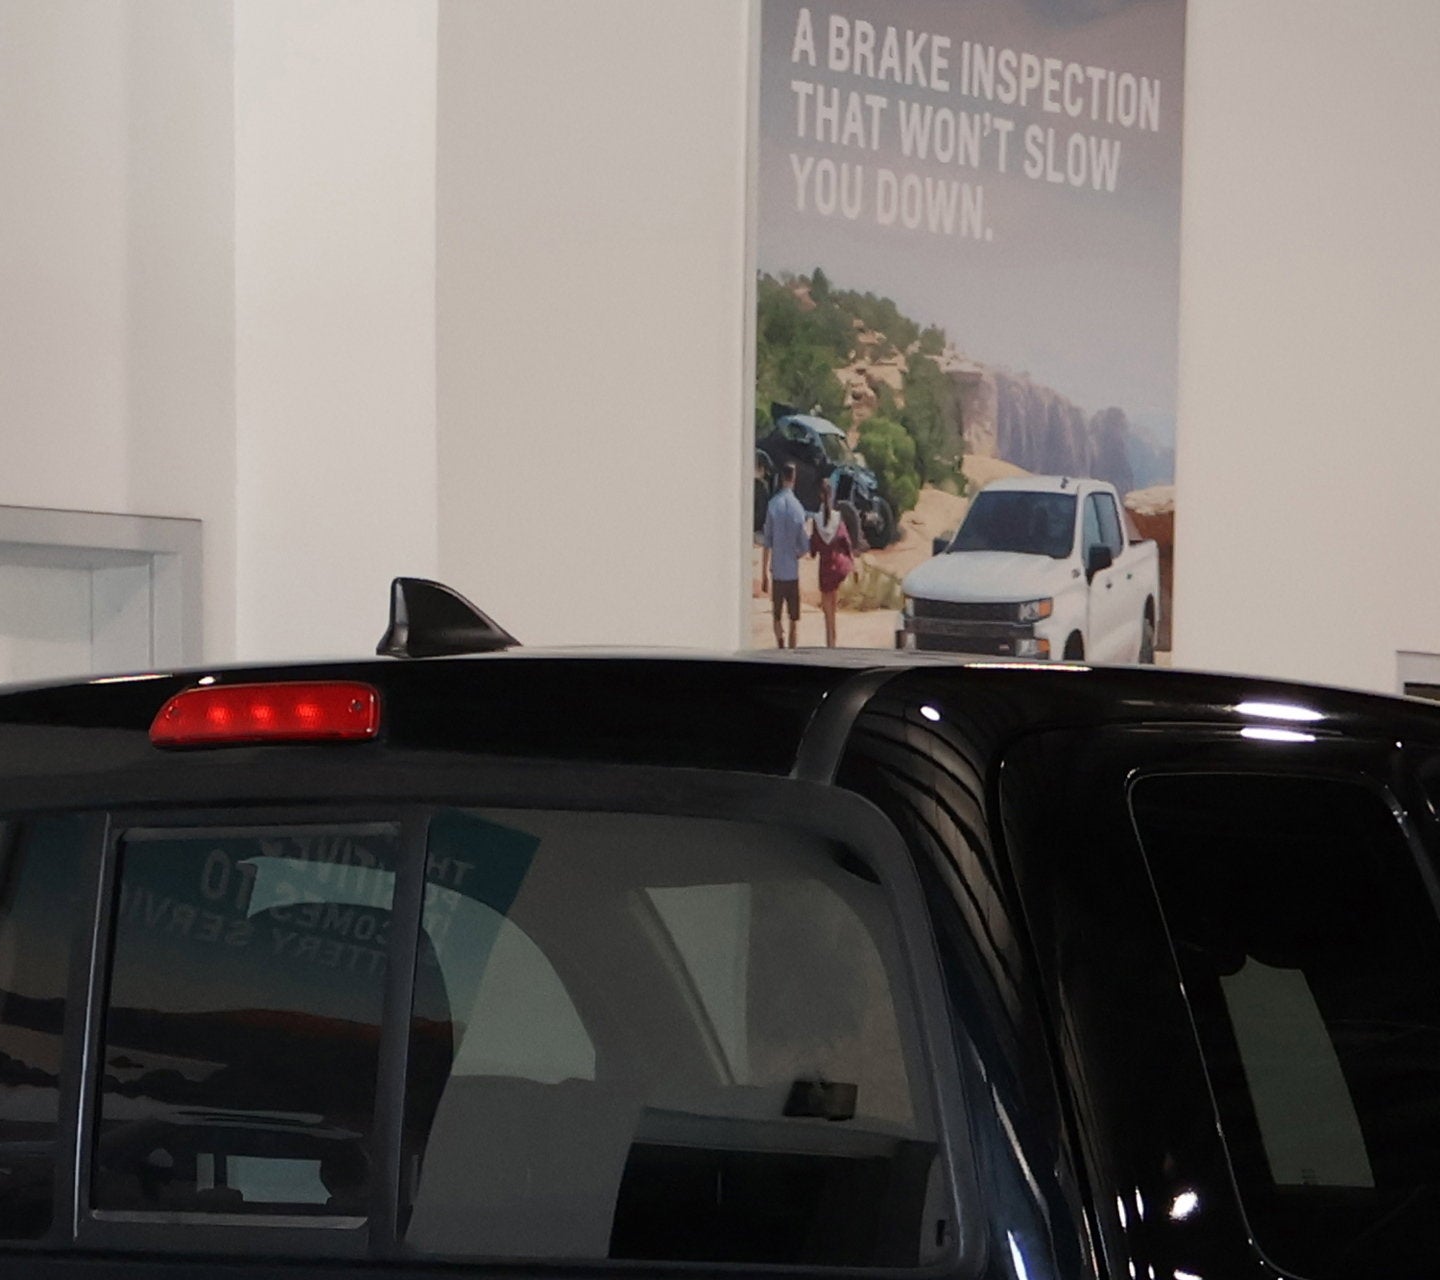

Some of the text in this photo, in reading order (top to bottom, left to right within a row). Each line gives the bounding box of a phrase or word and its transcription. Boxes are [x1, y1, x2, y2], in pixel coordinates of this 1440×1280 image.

[792, 8, 1161, 132] A BRAKE INSPECTION
[791, 80, 1121, 192] THAT WON'T SLOW
[790, 153, 993, 241] YOU DOWN.
